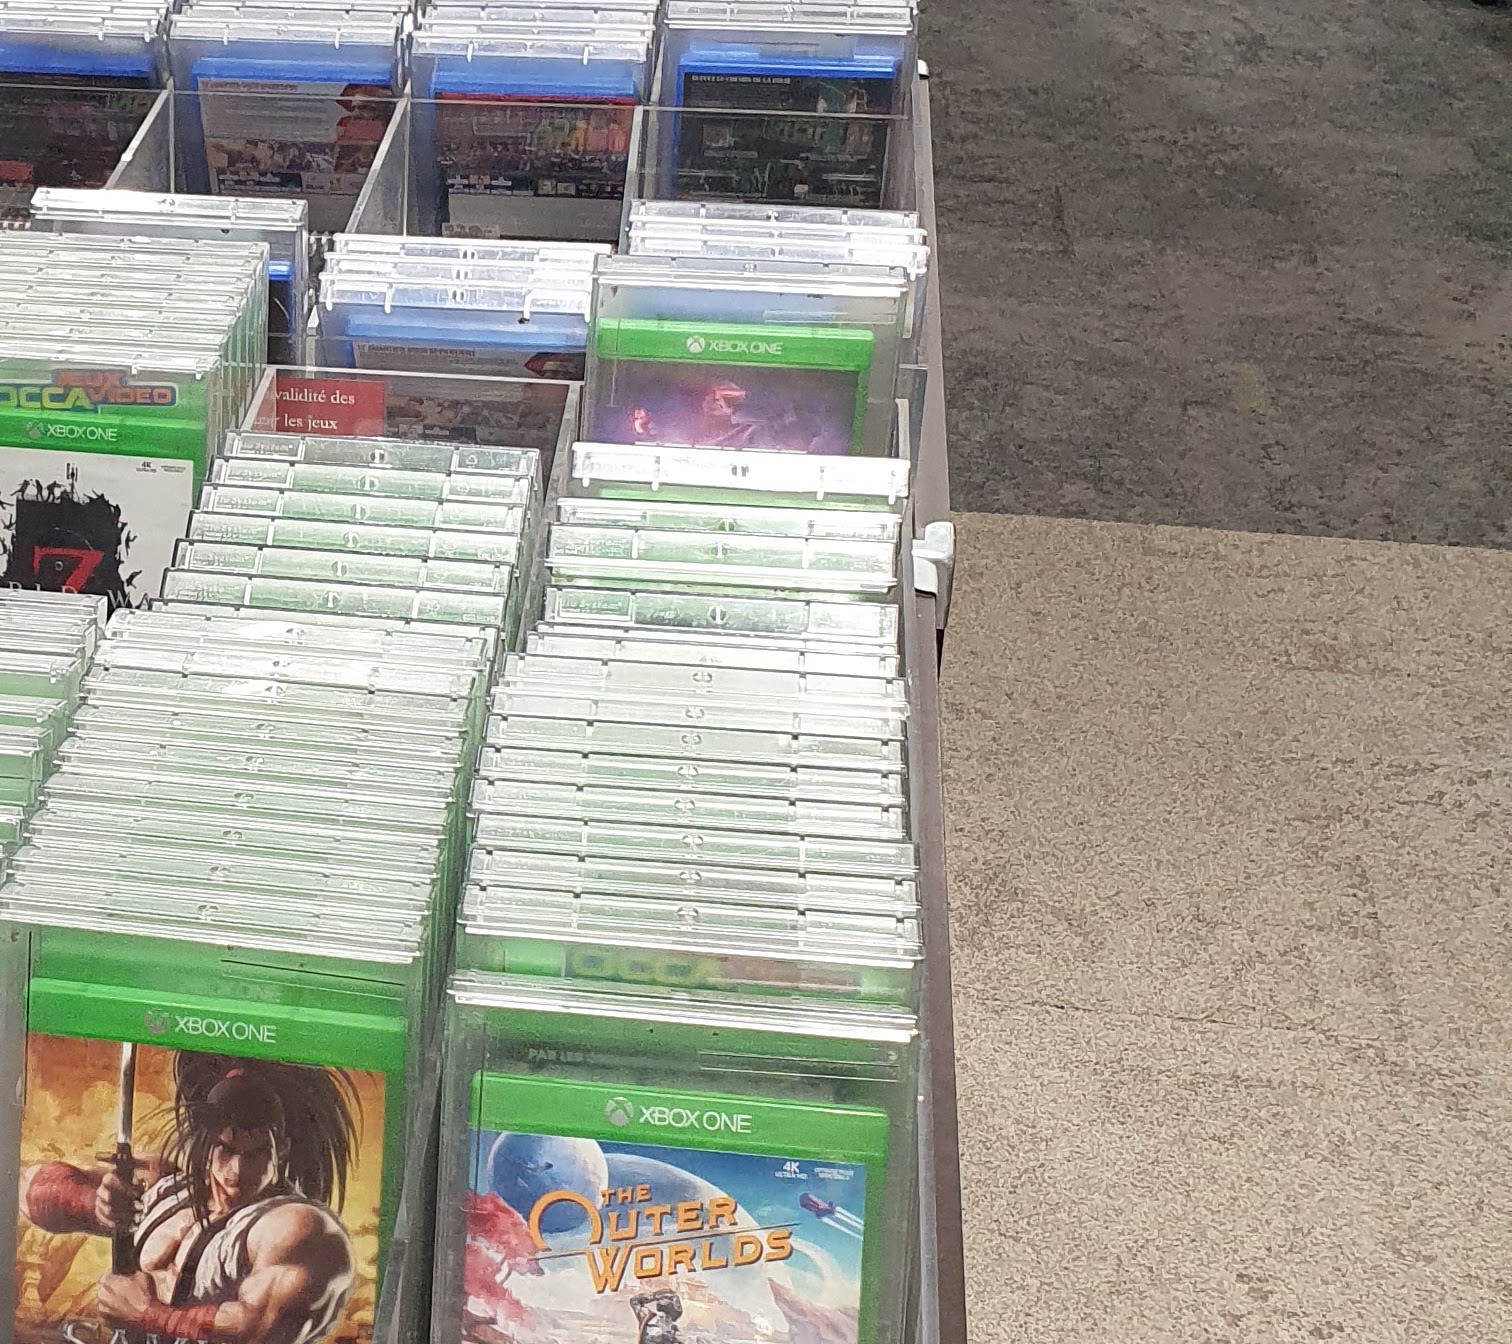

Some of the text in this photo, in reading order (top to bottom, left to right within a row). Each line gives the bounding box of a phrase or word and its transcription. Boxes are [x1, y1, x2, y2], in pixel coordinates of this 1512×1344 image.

[709, 340, 784, 355] XBOX ONE
[272, 387, 355, 405] validité des
[284, 413, 303, 427] les
[308, 415, 338, 431] jeux
[46, 423, 118, 442] XBOX ONE
[174, 1014, 277, 1045] XBOX ONE
[639, 1105, 753, 1134] XBOX ONE
[782, 1160, 800, 1173] 4K
[601, 1184, 652, 1206] THE
[528, 1190, 739, 1252] OUTER
[586, 1229, 794, 1294] WORLDS
